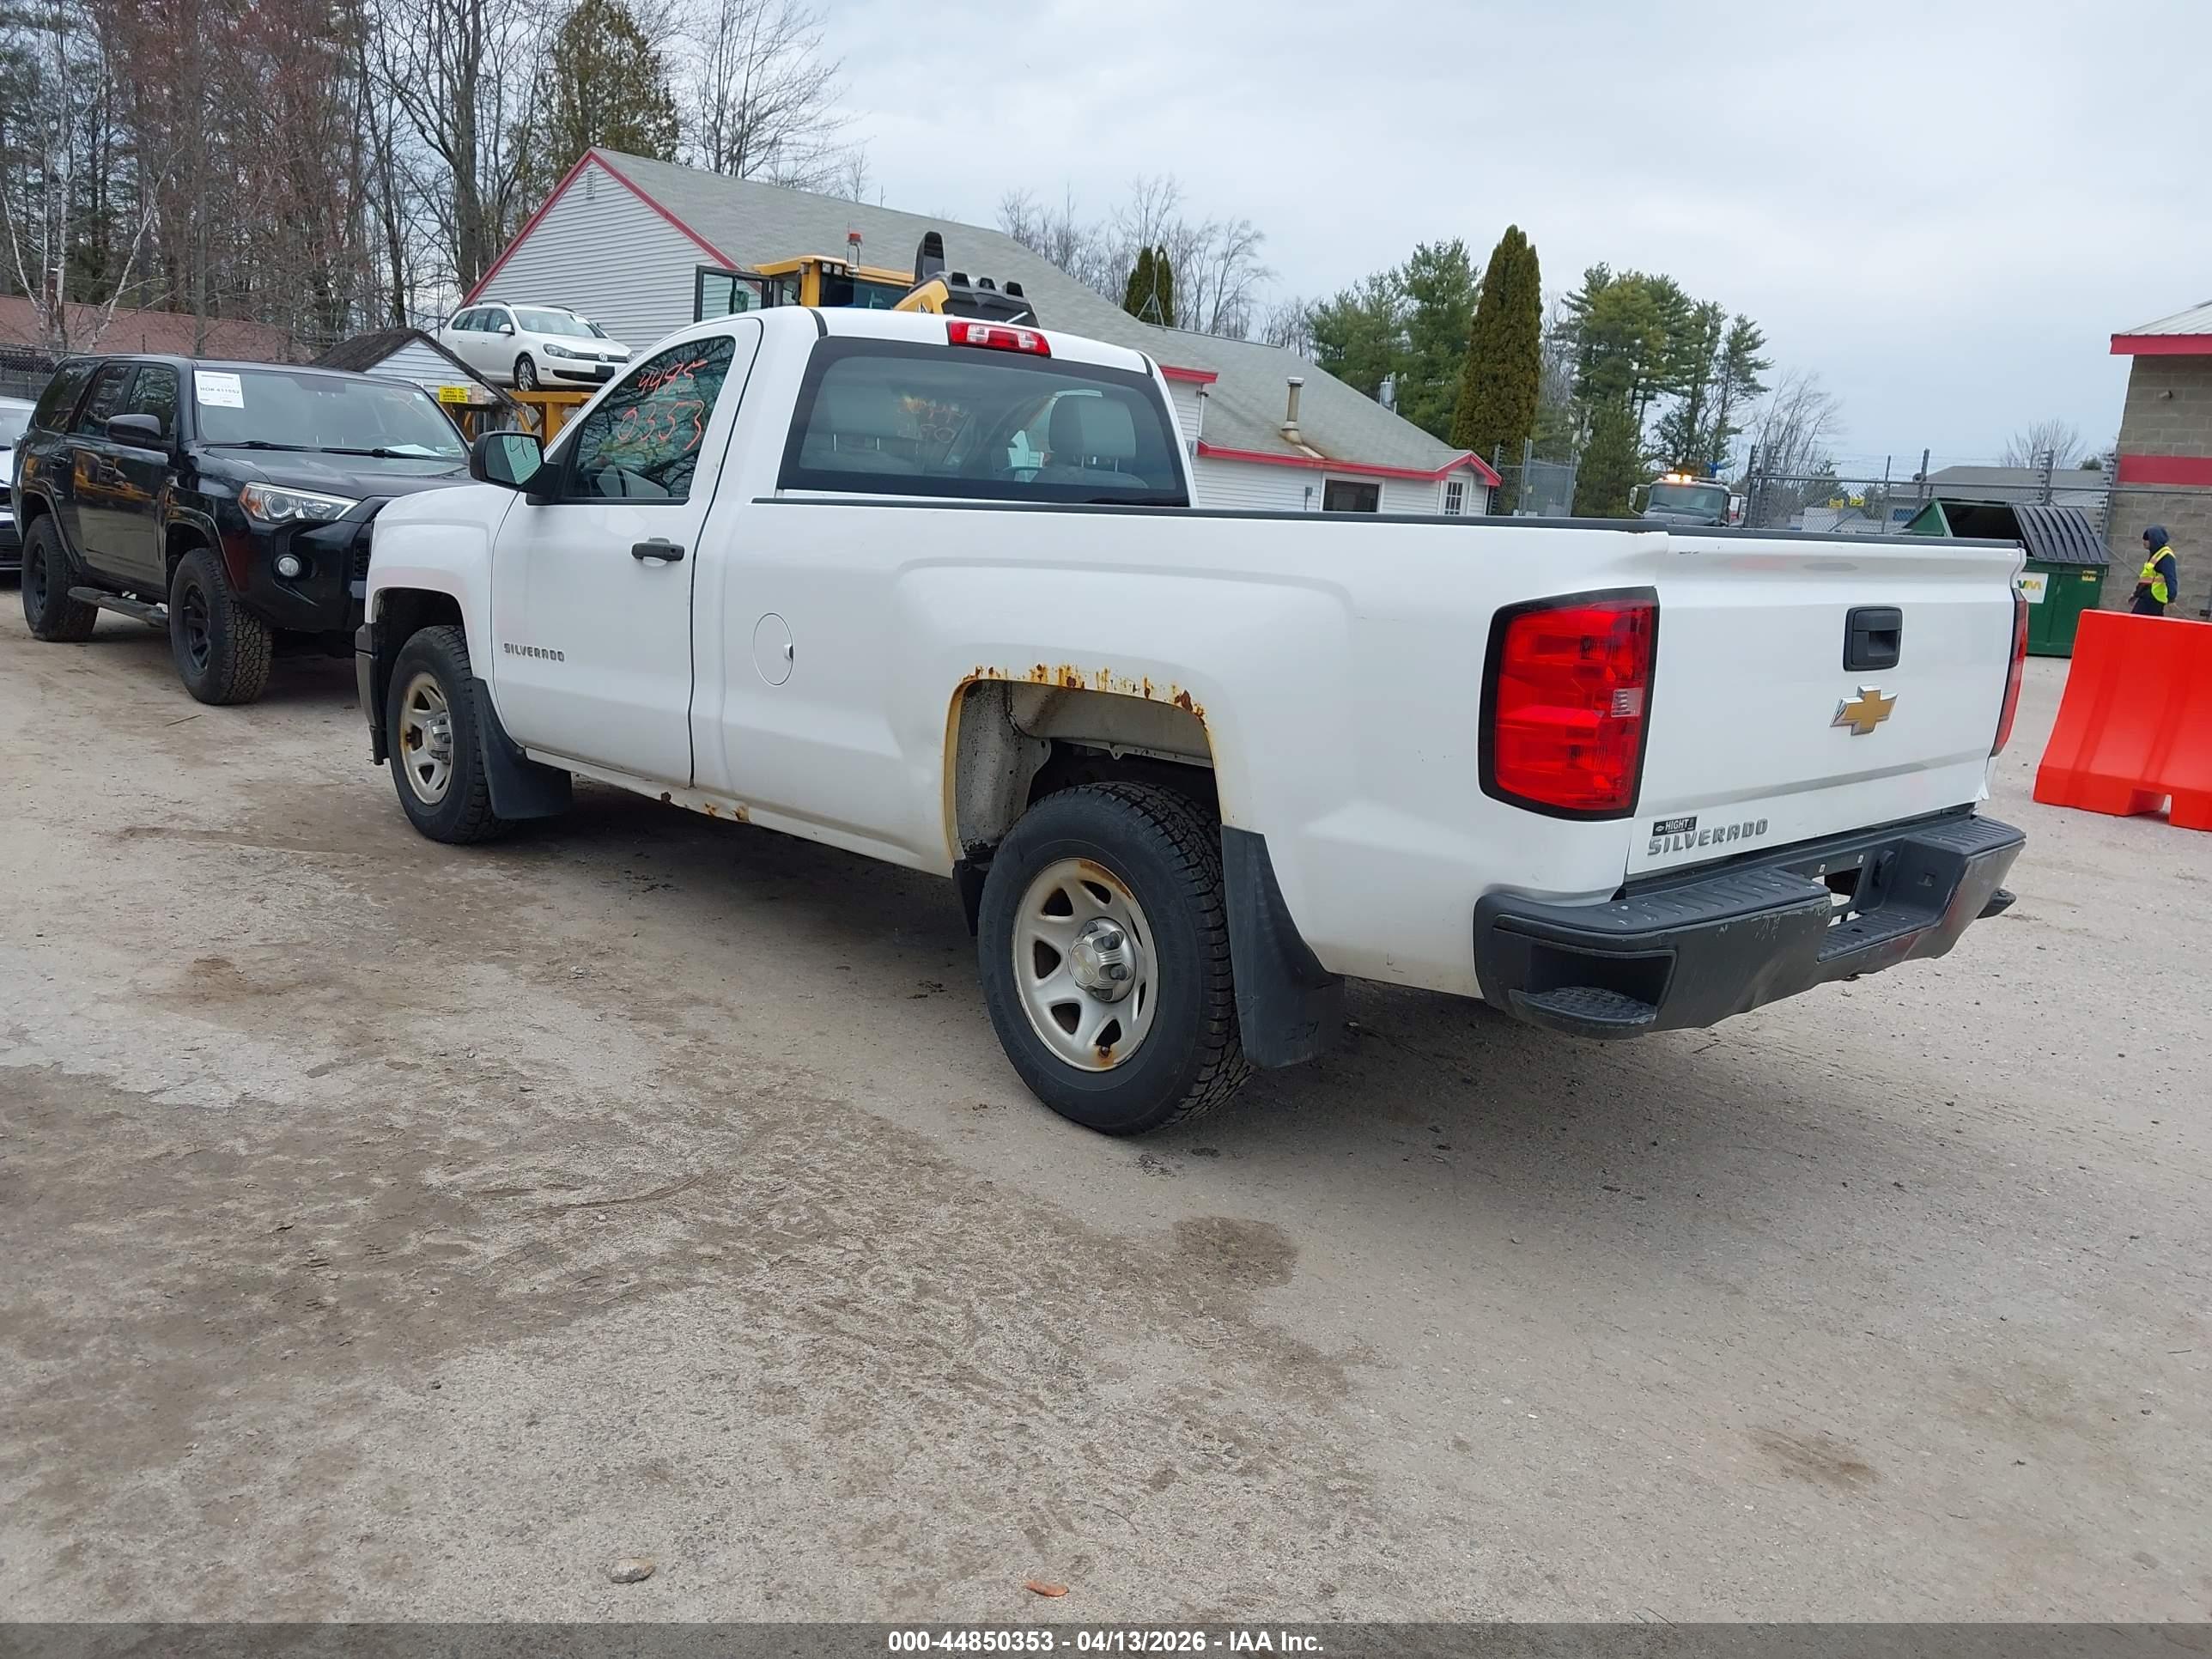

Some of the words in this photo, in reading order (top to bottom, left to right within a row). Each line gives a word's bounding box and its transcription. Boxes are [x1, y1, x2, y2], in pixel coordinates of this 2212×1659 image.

[617, 399, 705, 451] 0353
[504, 642, 565, 663] SILVERADO
[1648, 817, 1769, 856] SILVERADO
[1665, 818, 1689, 832] HIGHT
